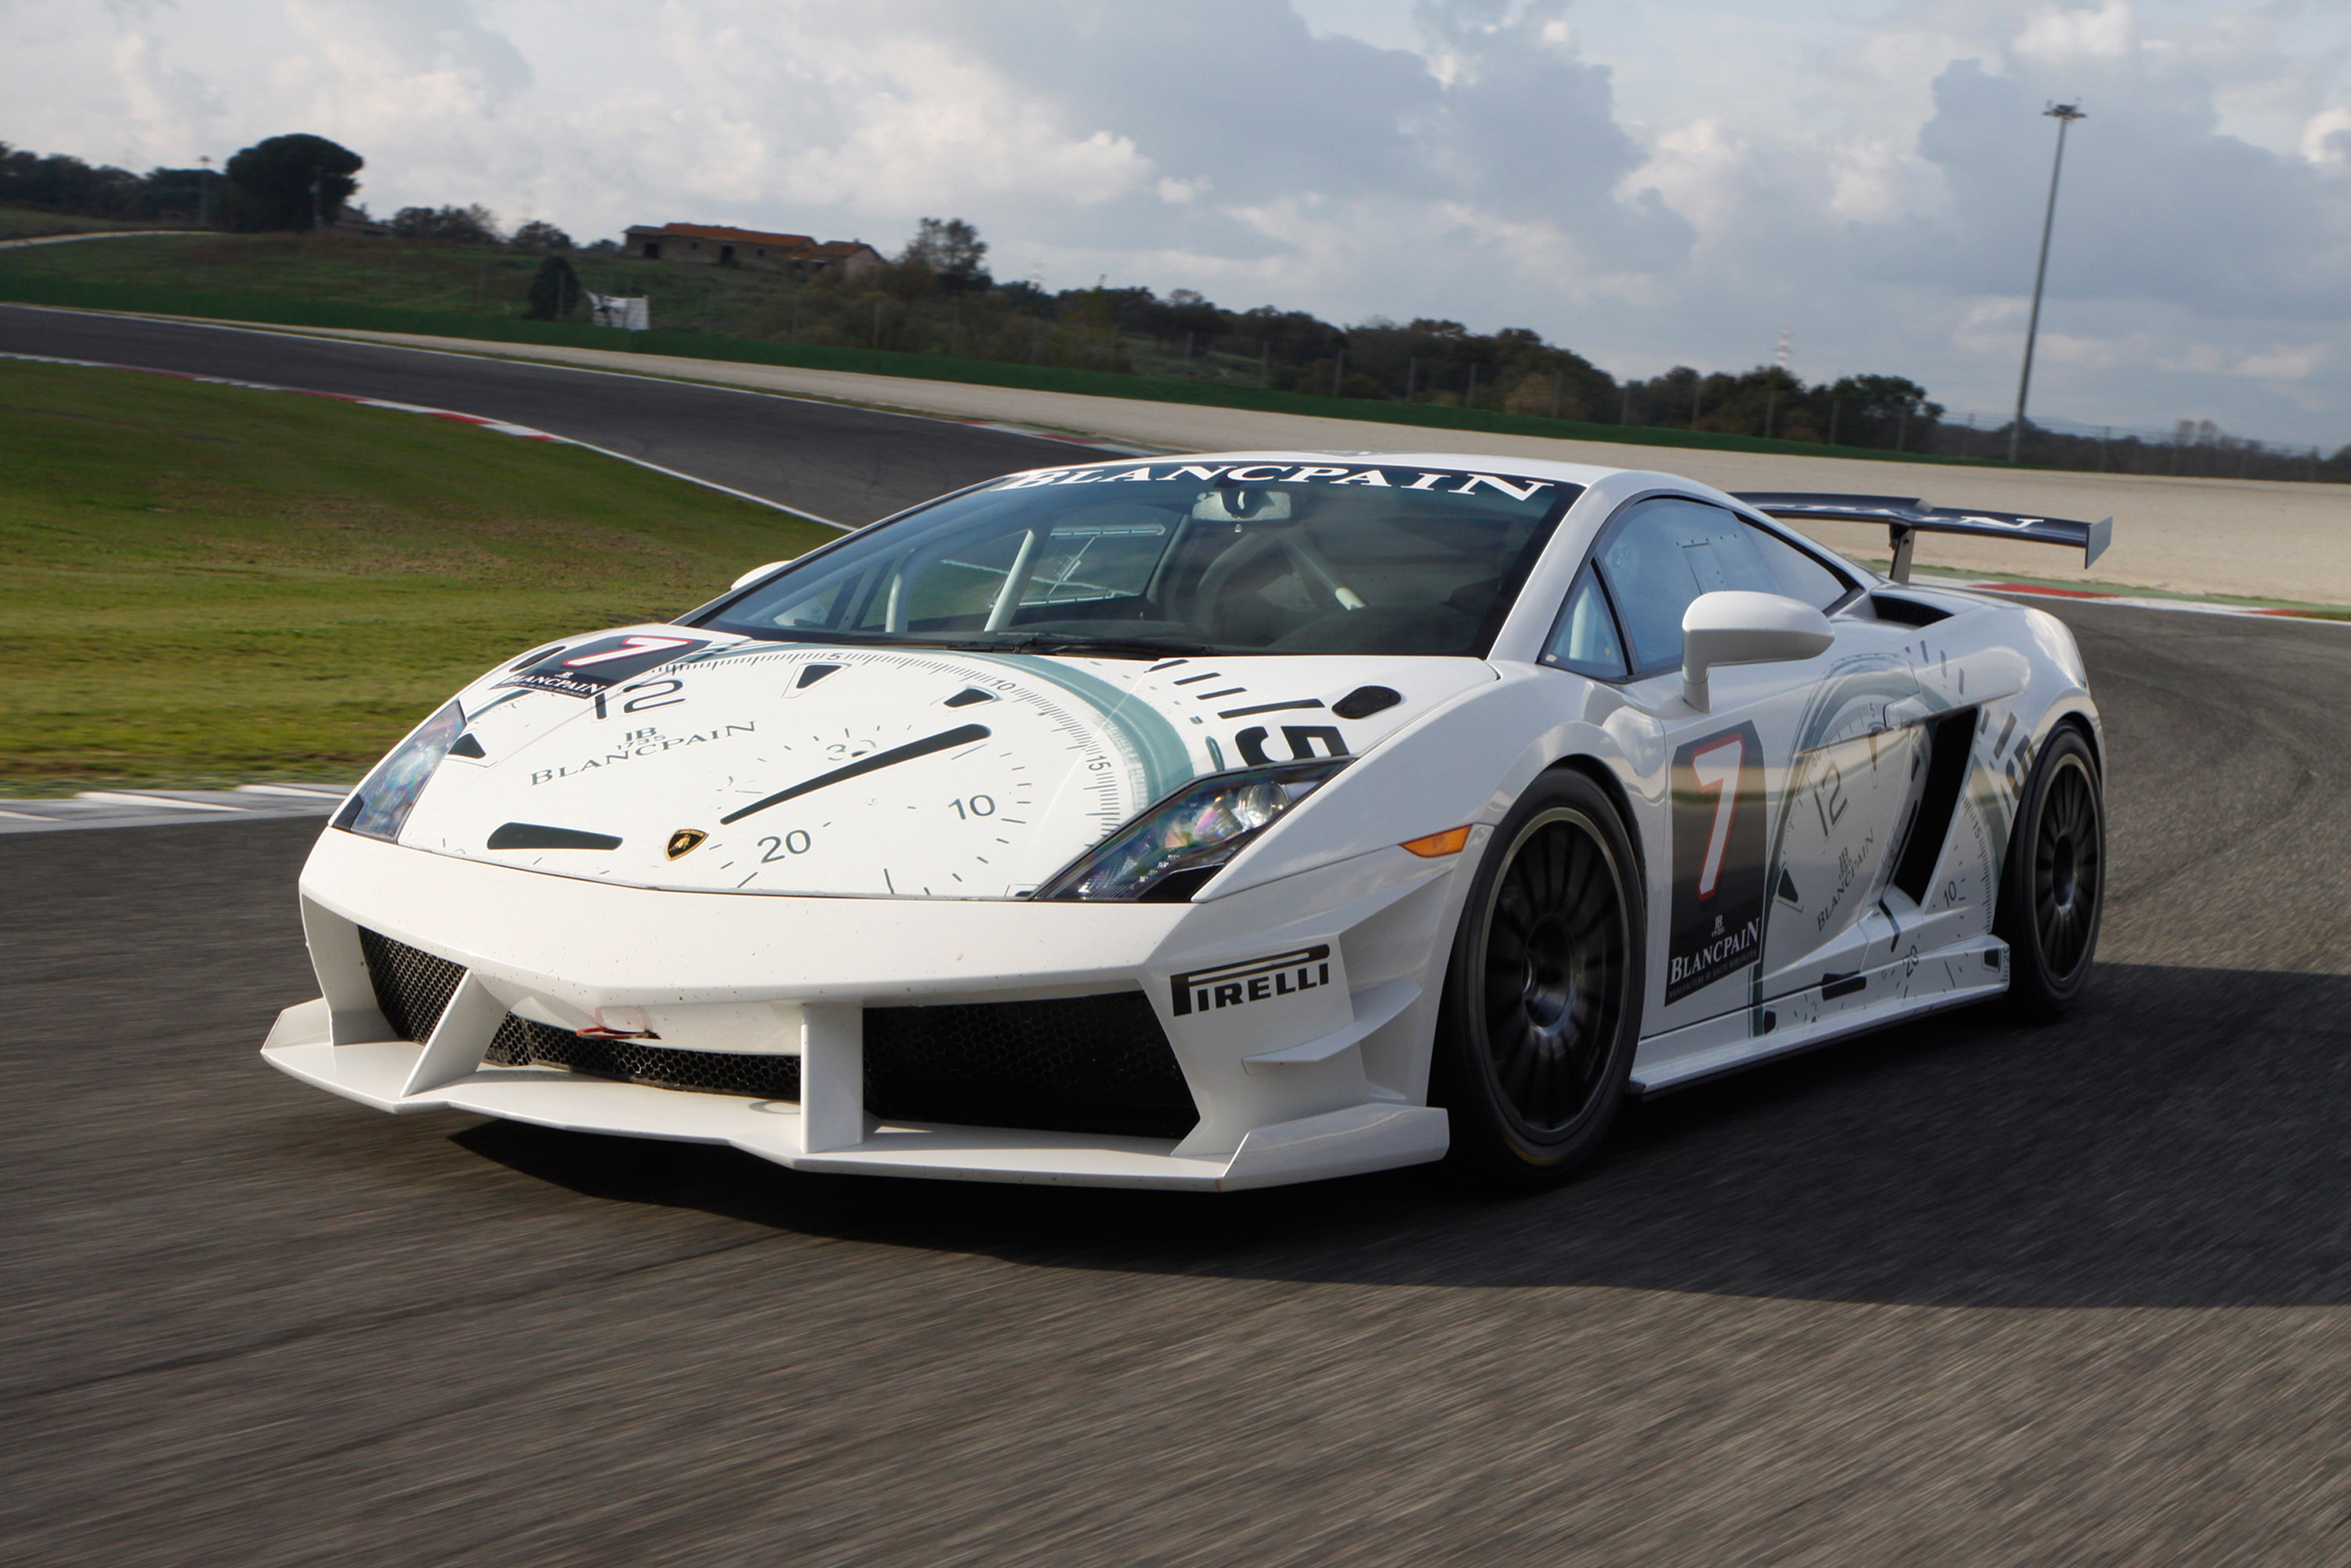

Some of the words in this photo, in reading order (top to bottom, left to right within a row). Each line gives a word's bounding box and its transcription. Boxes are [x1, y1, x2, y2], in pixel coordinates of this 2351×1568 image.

[989, 465, 1554, 502] BLANCPAIN
[560, 636, 694, 668] 7
[826, 651, 844, 661] 5
[594, 679, 687, 720] 12
[989, 679, 1016, 690] 10
[531, 721, 755, 786] BLANCPAIN
[1085, 755, 1112, 771] 15
[949, 794, 996, 820] 10
[1690, 732, 1745, 902] 7
[1813, 761, 1849, 838] 12
[756, 828, 812, 864] 20
[1816, 827, 1875, 932] BLANCPAIN
[1943, 881, 1957, 908] 10
[1670, 918, 1760, 985] BLANCPAIN
[1170, 943, 1331, 1017] PIRELLI
